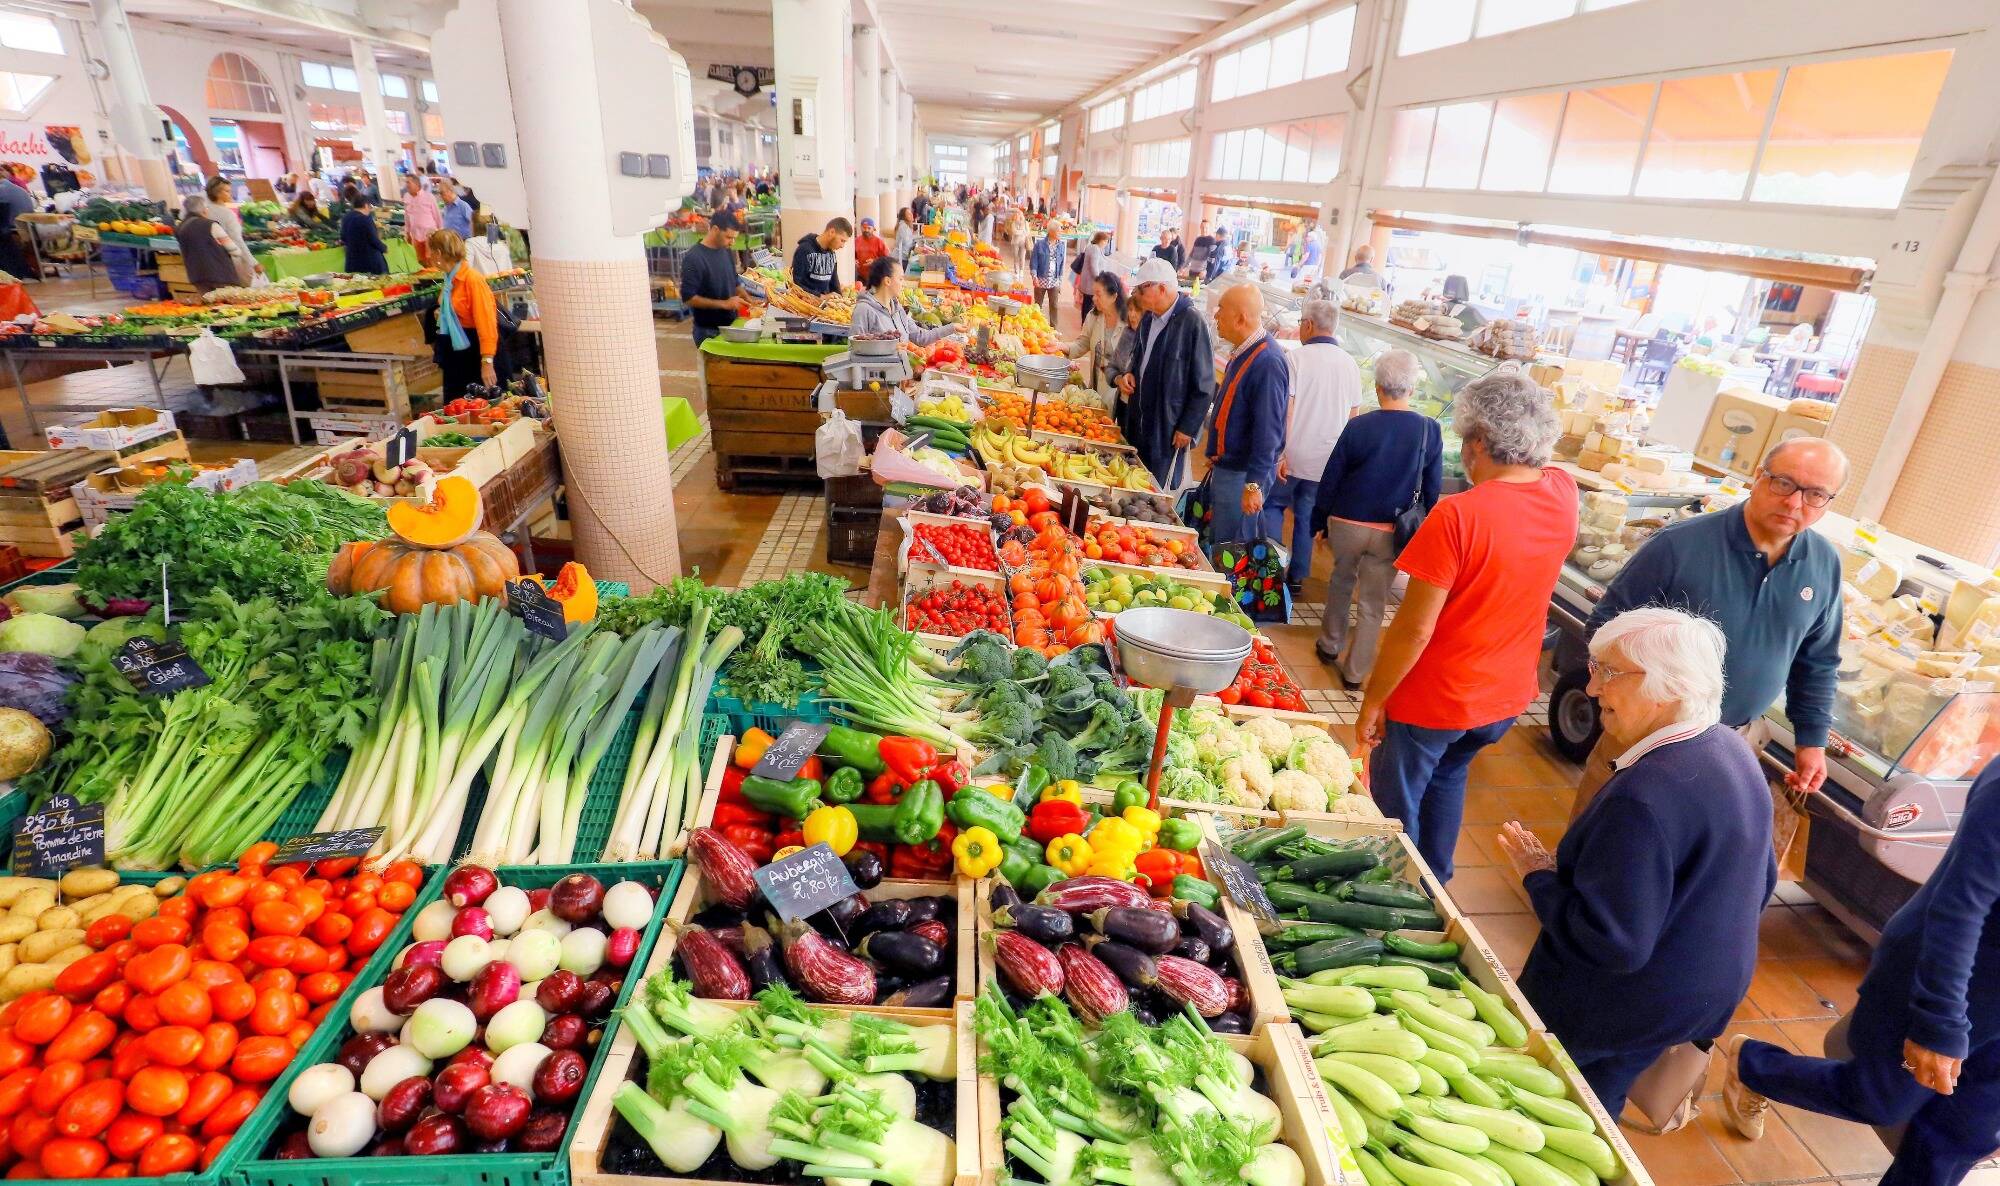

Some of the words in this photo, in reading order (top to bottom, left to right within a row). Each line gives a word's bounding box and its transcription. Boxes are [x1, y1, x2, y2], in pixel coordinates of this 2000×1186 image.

[1905, 240, 1920, 252] 13
[760, 395, 811, 406] JAUM
[48, 796, 70, 809] 1kg
[32, 833, 67, 851] Pomme
[68, 830, 83, 845] de
[79, 826, 105, 841] Terre
[41, 845, 93, 865] Amandine
[1251, 939, 1272, 975] superalp
